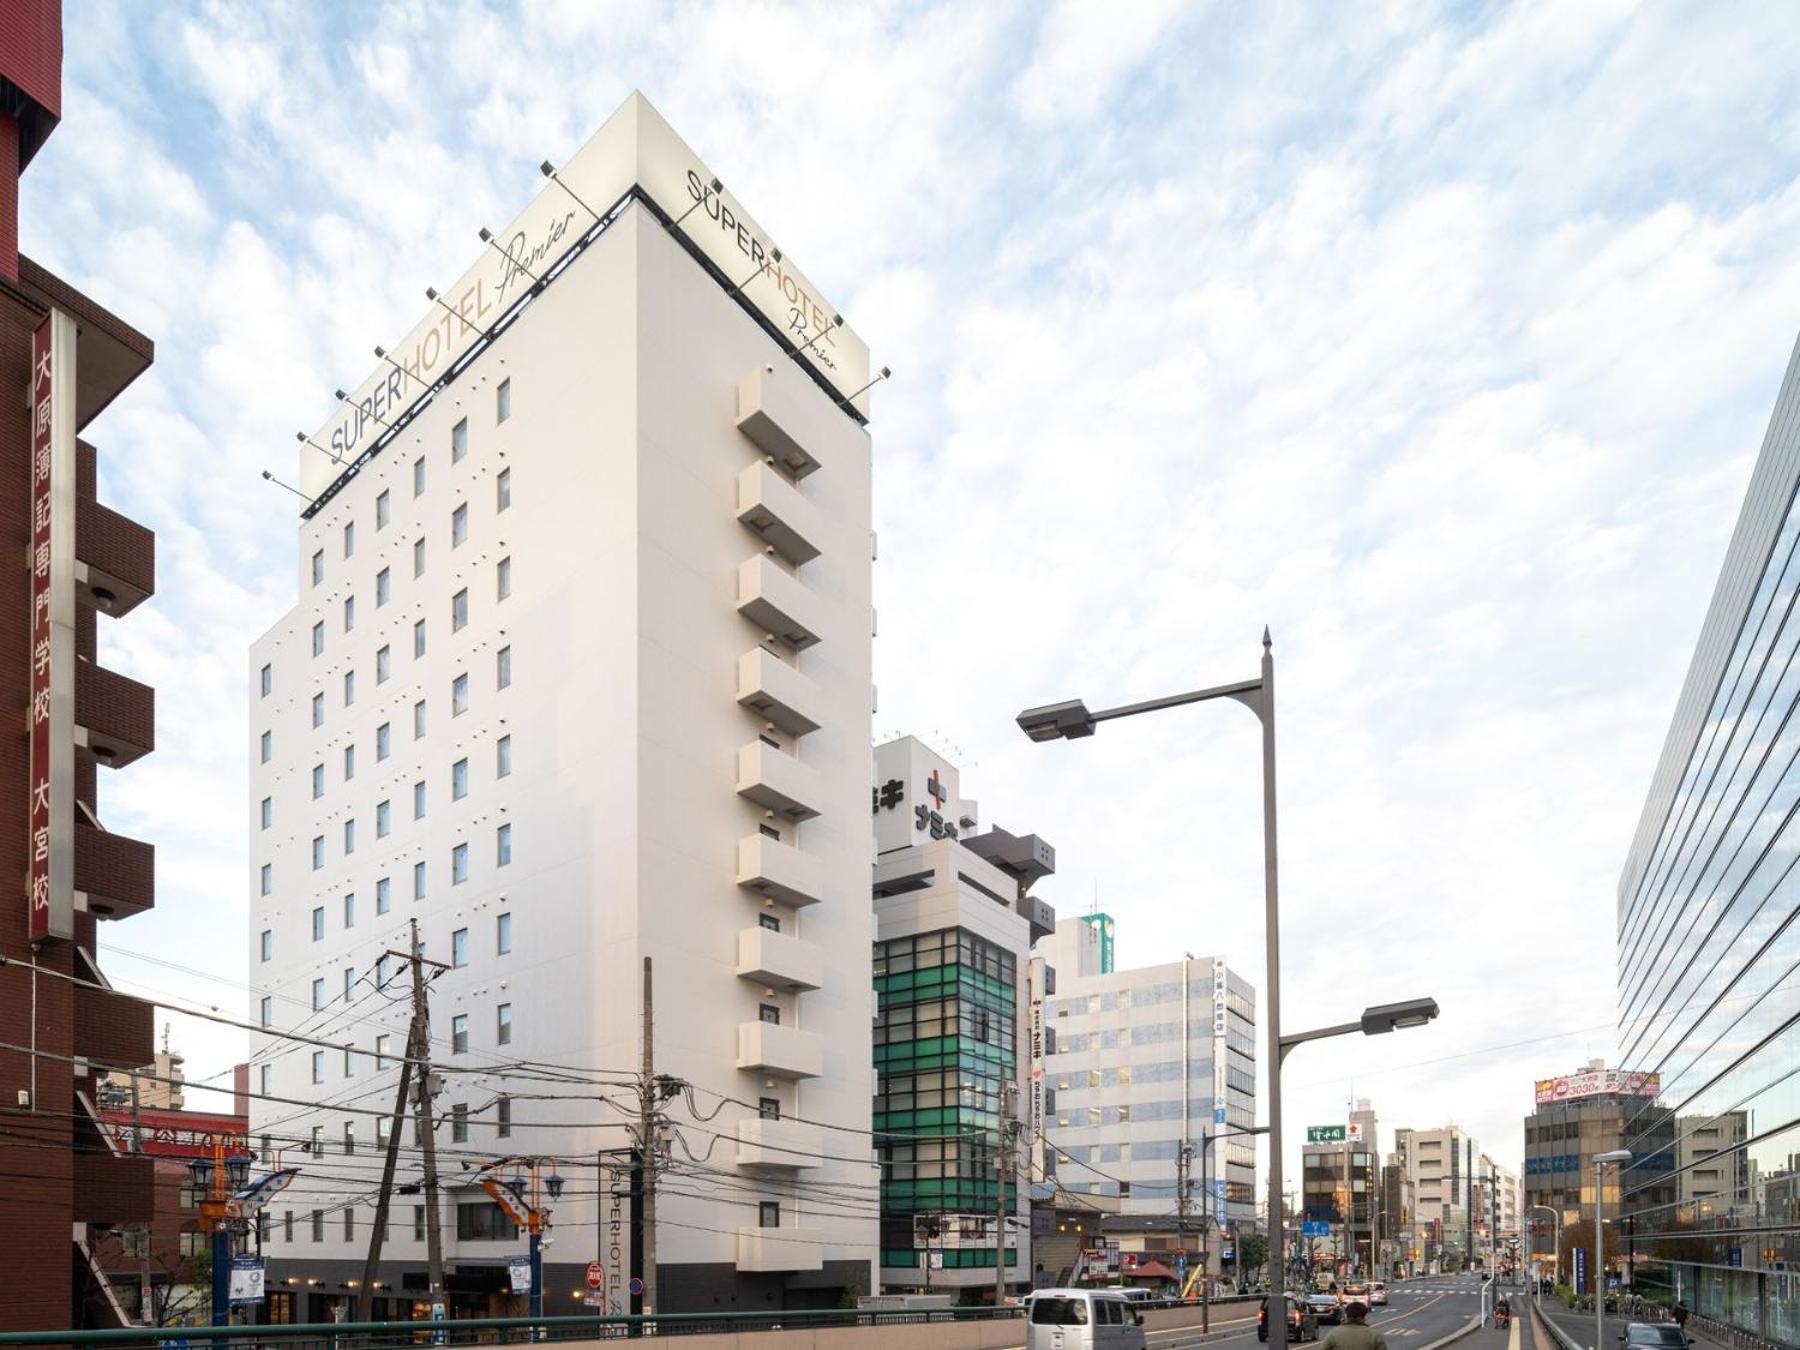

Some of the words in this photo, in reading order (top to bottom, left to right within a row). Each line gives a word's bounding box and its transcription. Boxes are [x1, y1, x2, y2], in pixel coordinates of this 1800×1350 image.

[687, 168, 836, 348] SUPERHOTEL
[330, 278, 492, 466] SUPERHOTEL
[495, 210, 576, 305] Premier
[789, 307, 839, 371] Premier
[35, 350, 51, 726] 大原簿記専門学校
[33, 777, 50, 912] 大宮校
[873, 779, 905, 814] キ
[610, 1169, 621, 1296] SUPERHOTEL
